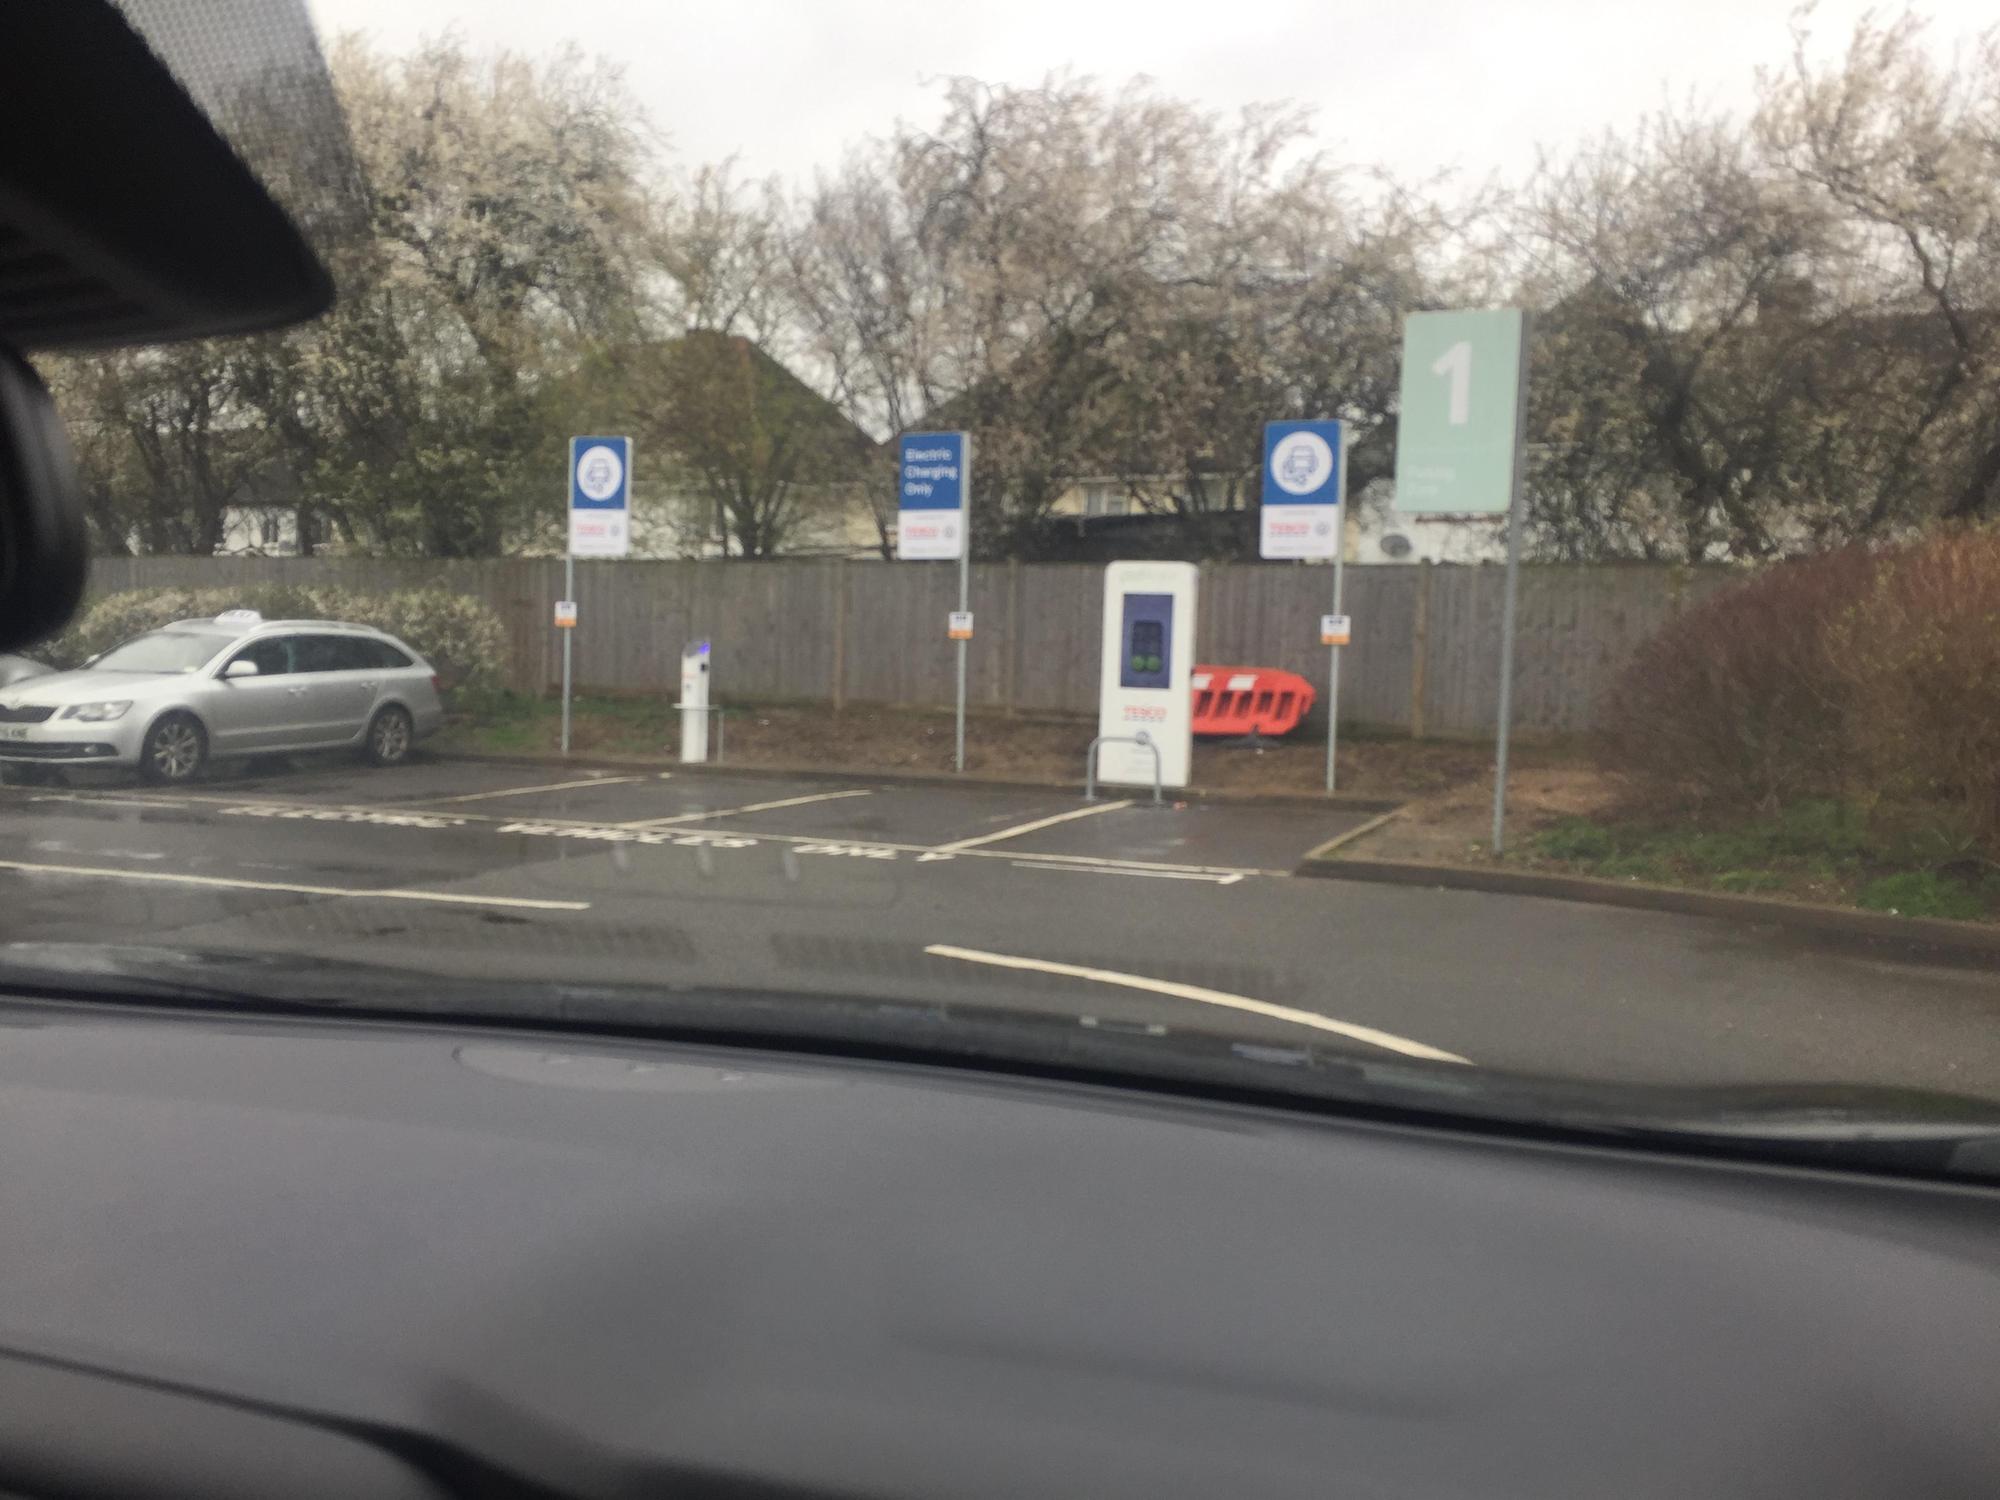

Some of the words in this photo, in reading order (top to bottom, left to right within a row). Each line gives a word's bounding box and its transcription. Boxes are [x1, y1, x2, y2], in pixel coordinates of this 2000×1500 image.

[1431, 340, 1472, 425] 1
[905, 448, 952, 461] Electric
[905, 465, 958, 480] Charging
[904, 482, 933, 497] Only
